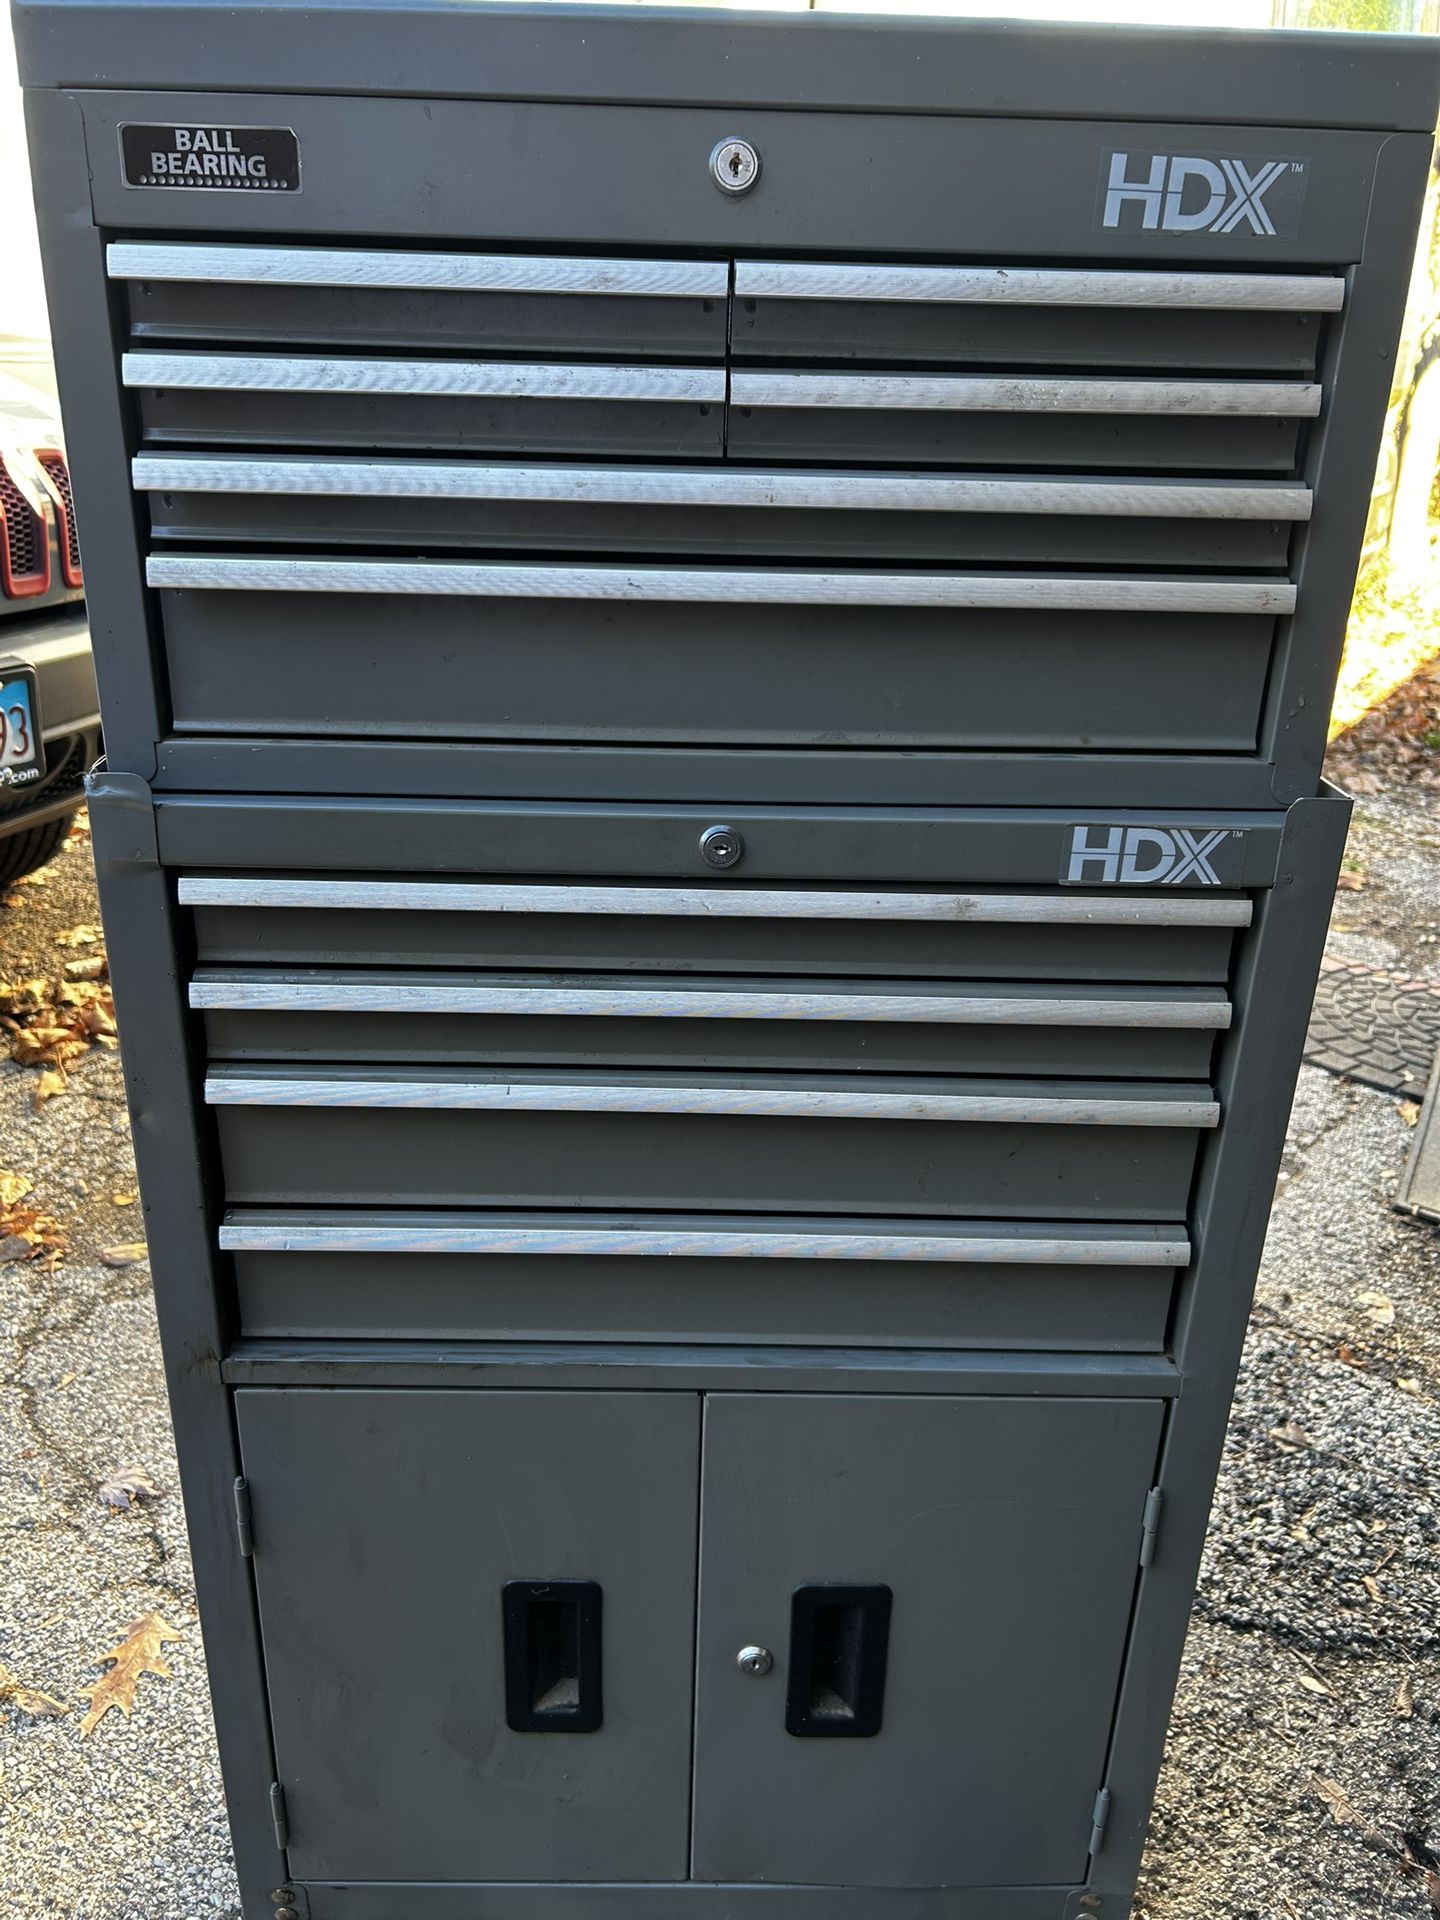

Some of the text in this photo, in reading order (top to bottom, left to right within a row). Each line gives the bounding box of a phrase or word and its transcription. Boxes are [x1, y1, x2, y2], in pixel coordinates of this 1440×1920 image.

[175, 129, 240, 153] BALL
[151, 152, 267, 177] BEARING
[1103, 152, 1289, 235] HDX
[1068, 826, 1230, 885] HDX
